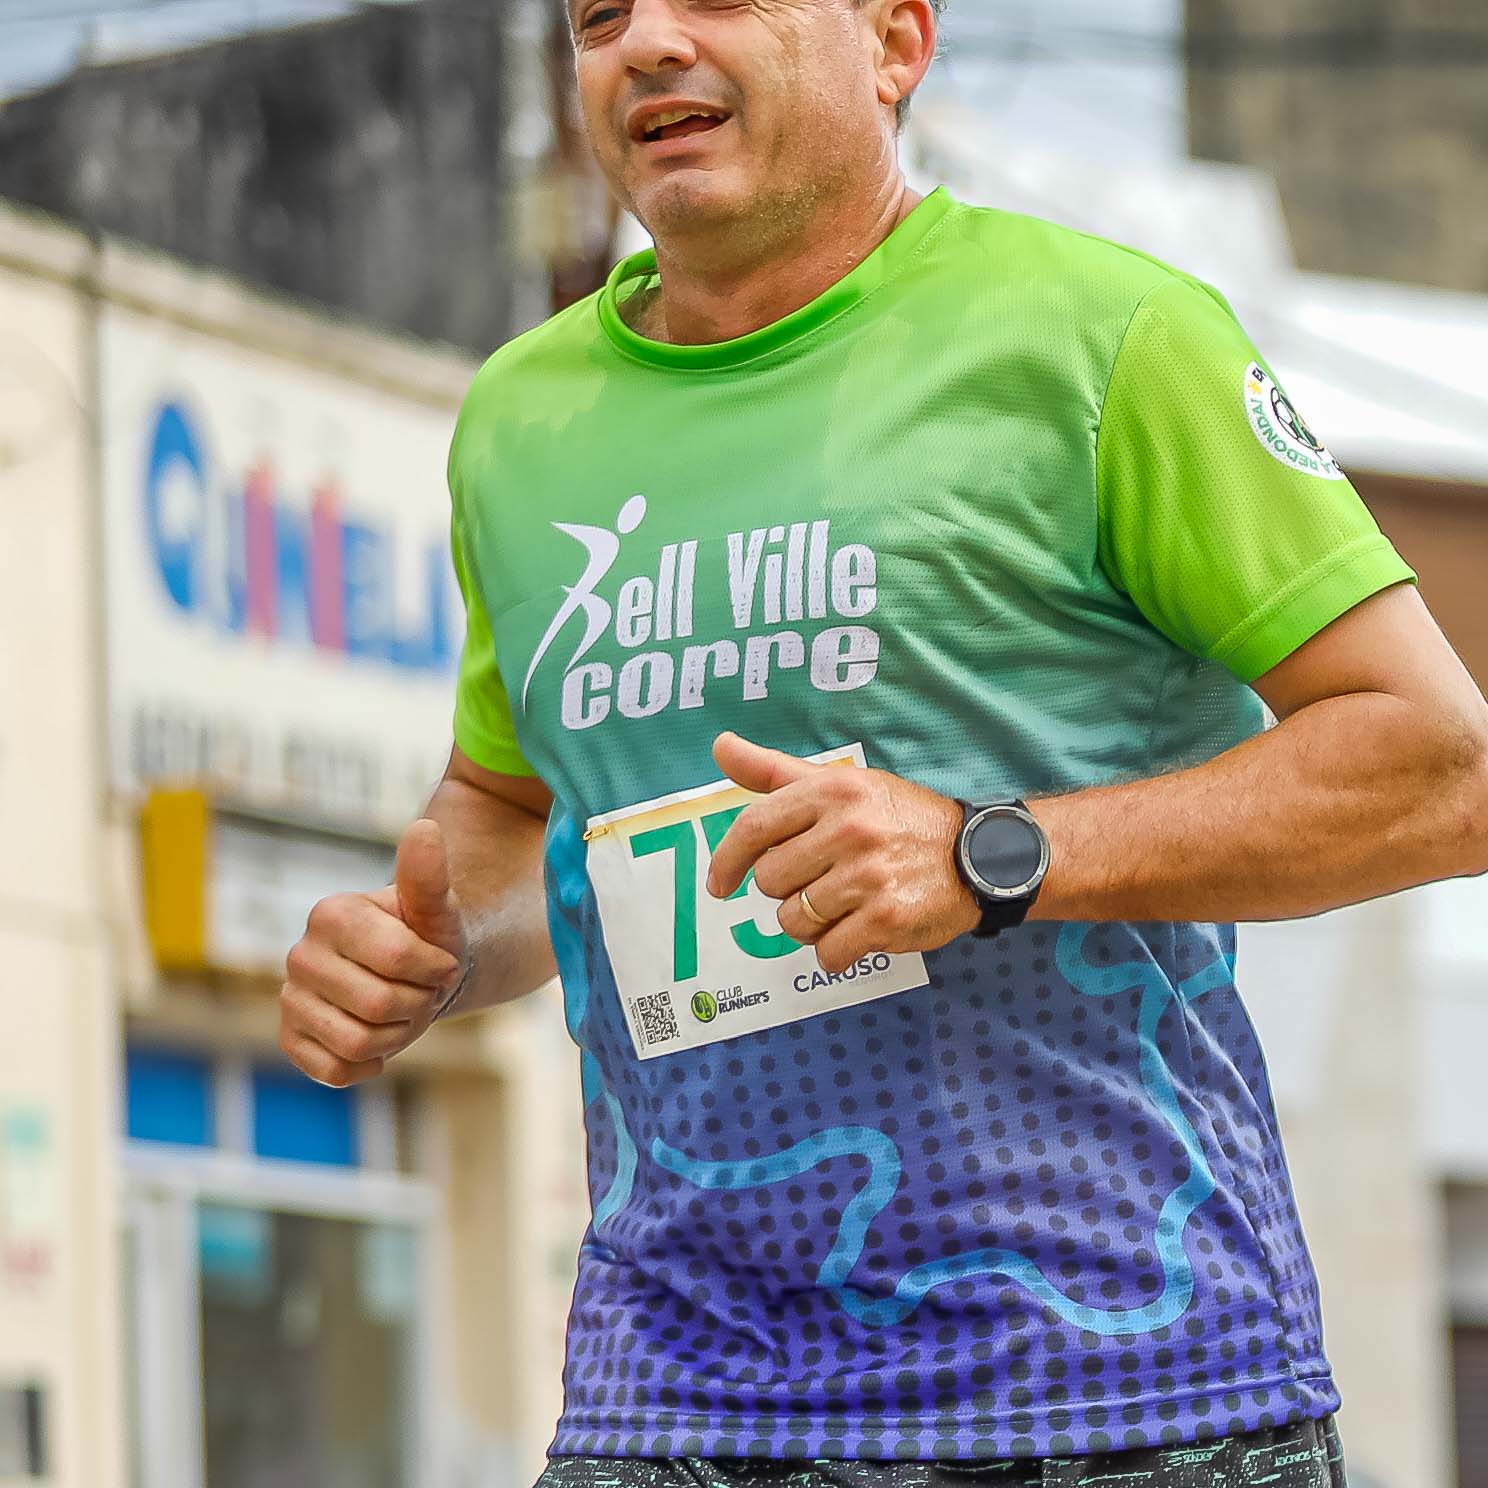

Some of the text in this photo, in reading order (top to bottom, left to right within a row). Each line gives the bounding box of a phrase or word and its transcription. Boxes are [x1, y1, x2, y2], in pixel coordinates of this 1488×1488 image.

[727, 519, 878, 629] Ville
[716, 985, 744, 1002] CLUB
[718, 990, 770, 1015] RUNNER'S
